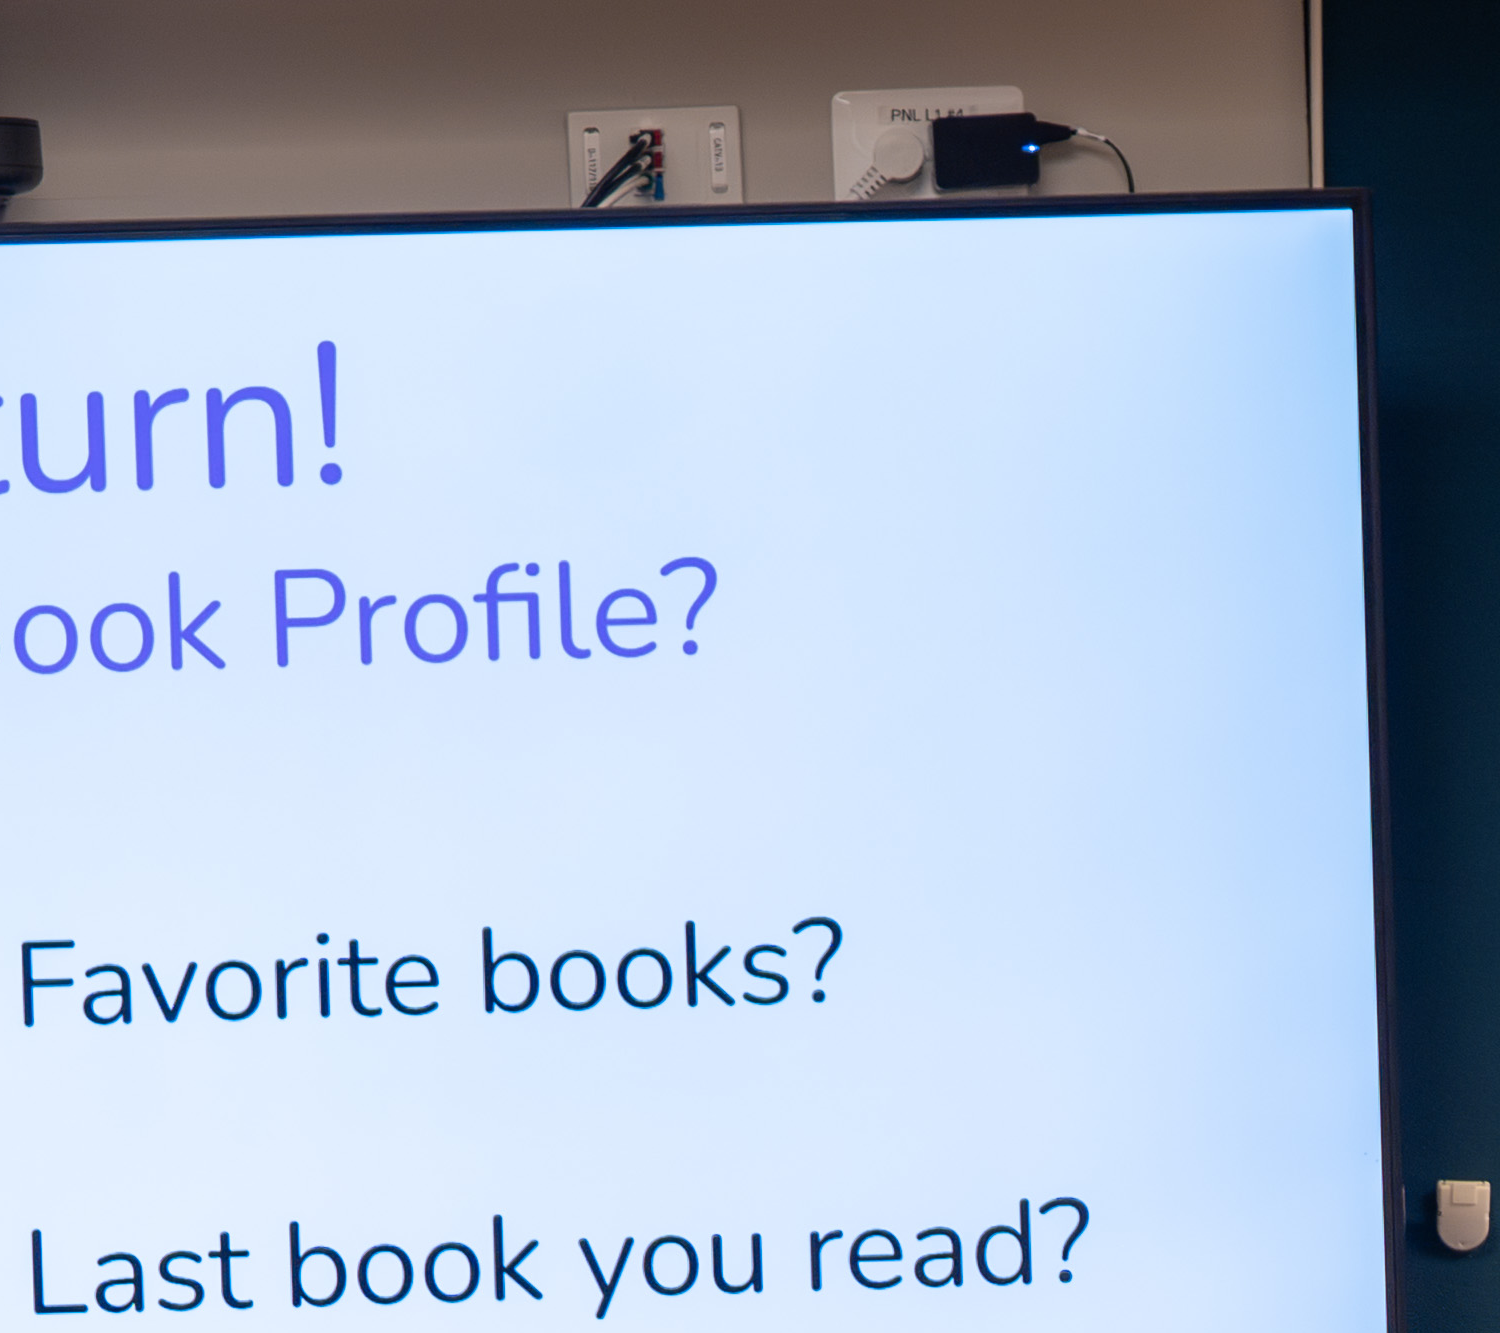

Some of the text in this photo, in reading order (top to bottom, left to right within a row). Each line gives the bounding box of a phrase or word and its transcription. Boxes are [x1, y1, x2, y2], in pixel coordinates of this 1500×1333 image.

[891, 108, 922, 123] PNL
[274, 556, 718, 668] Profile?
[21, 916, 843, 1028] Favorite books?
[31, 1197, 1090, 1320] Last book you read?
